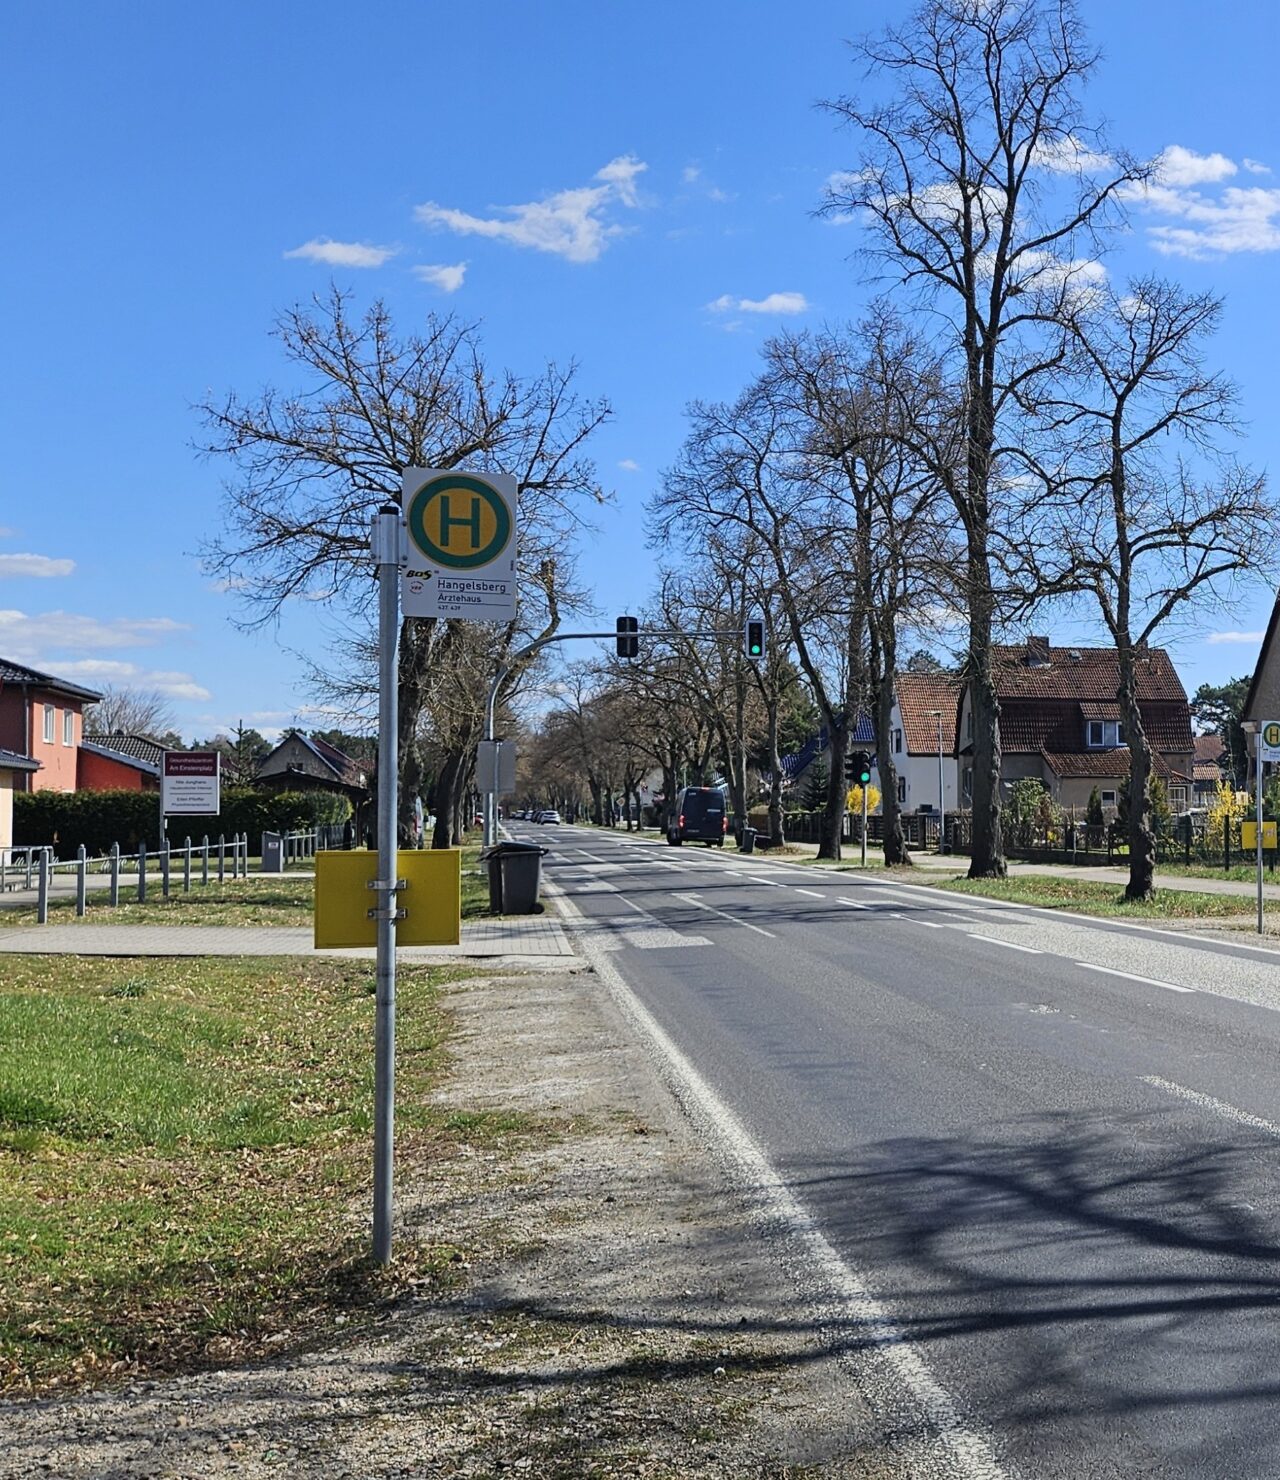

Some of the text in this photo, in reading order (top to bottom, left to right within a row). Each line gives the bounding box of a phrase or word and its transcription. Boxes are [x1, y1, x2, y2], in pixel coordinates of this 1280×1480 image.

[440, 495, 480, 547] H
[437, 579, 506, 593] Hangelsberg
[1269, 728, 1279, 742] H
